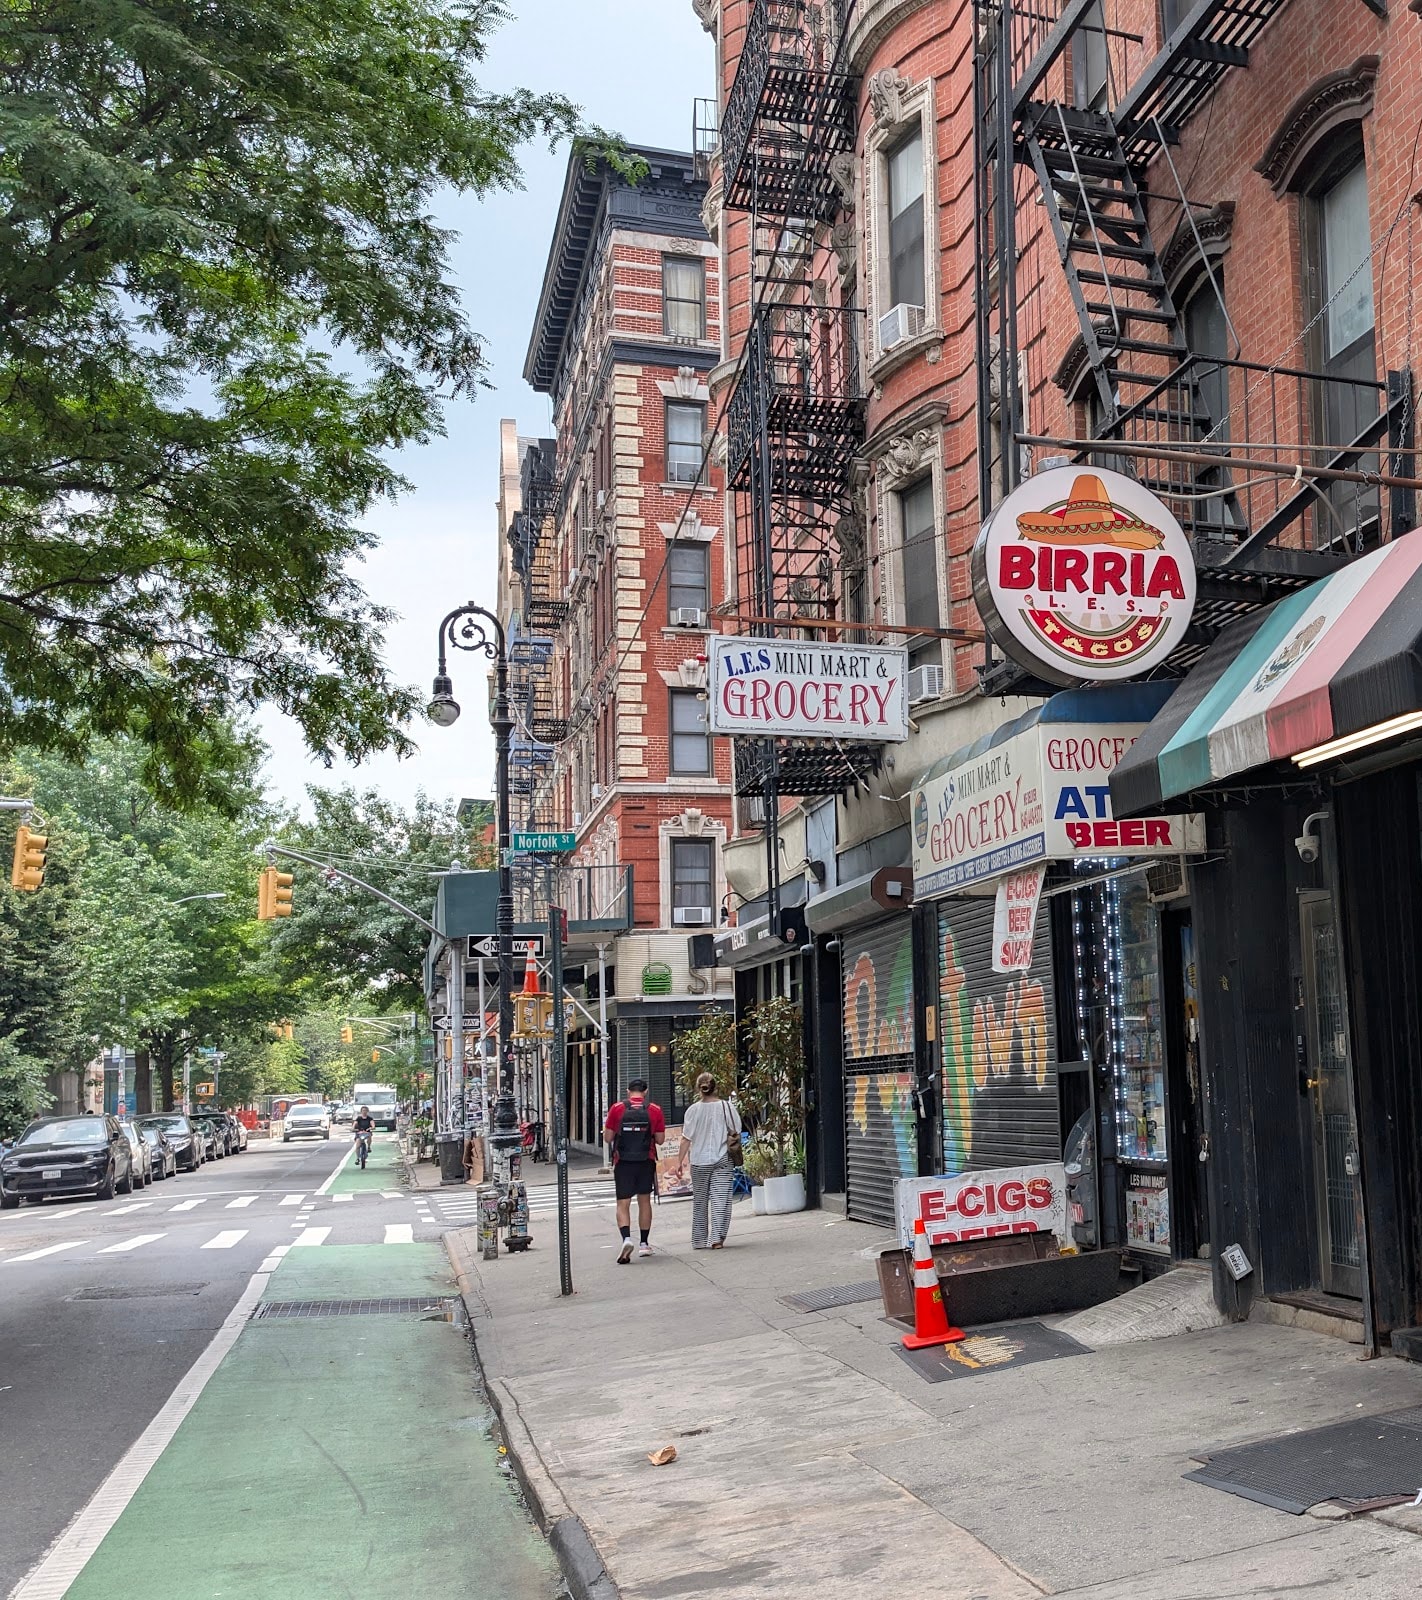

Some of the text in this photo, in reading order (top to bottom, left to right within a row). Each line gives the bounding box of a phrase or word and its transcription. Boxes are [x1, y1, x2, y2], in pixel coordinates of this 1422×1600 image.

[999, 545, 1186, 600] BIRRIA
[1049, 595, 1143, 613] L. E. S.
[1044, 616, 1153, 656] TACOS
[775, 652, 813, 675] MINI
[820, 655, 871, 678] MART
[877, 657, 889, 679] &
[722, 677, 898, 729] GROCERY
[957, 770, 975, 801] MINI
[977, 756, 1002, 792] MART
[1004, 752, 1011, 776] &
[930, 774, 1022, 864] GROCERY
[1065, 820, 1172, 848] BEER
[518, 835, 570, 848] Norfolk St
[1006, 871, 1039, 901] E-CIGS
[1008, 906, 1032, 933] BEER
[1130, 1173, 1167, 1189] LES MINI MART
[918, 1176, 1053, 1222] E-CIGS
